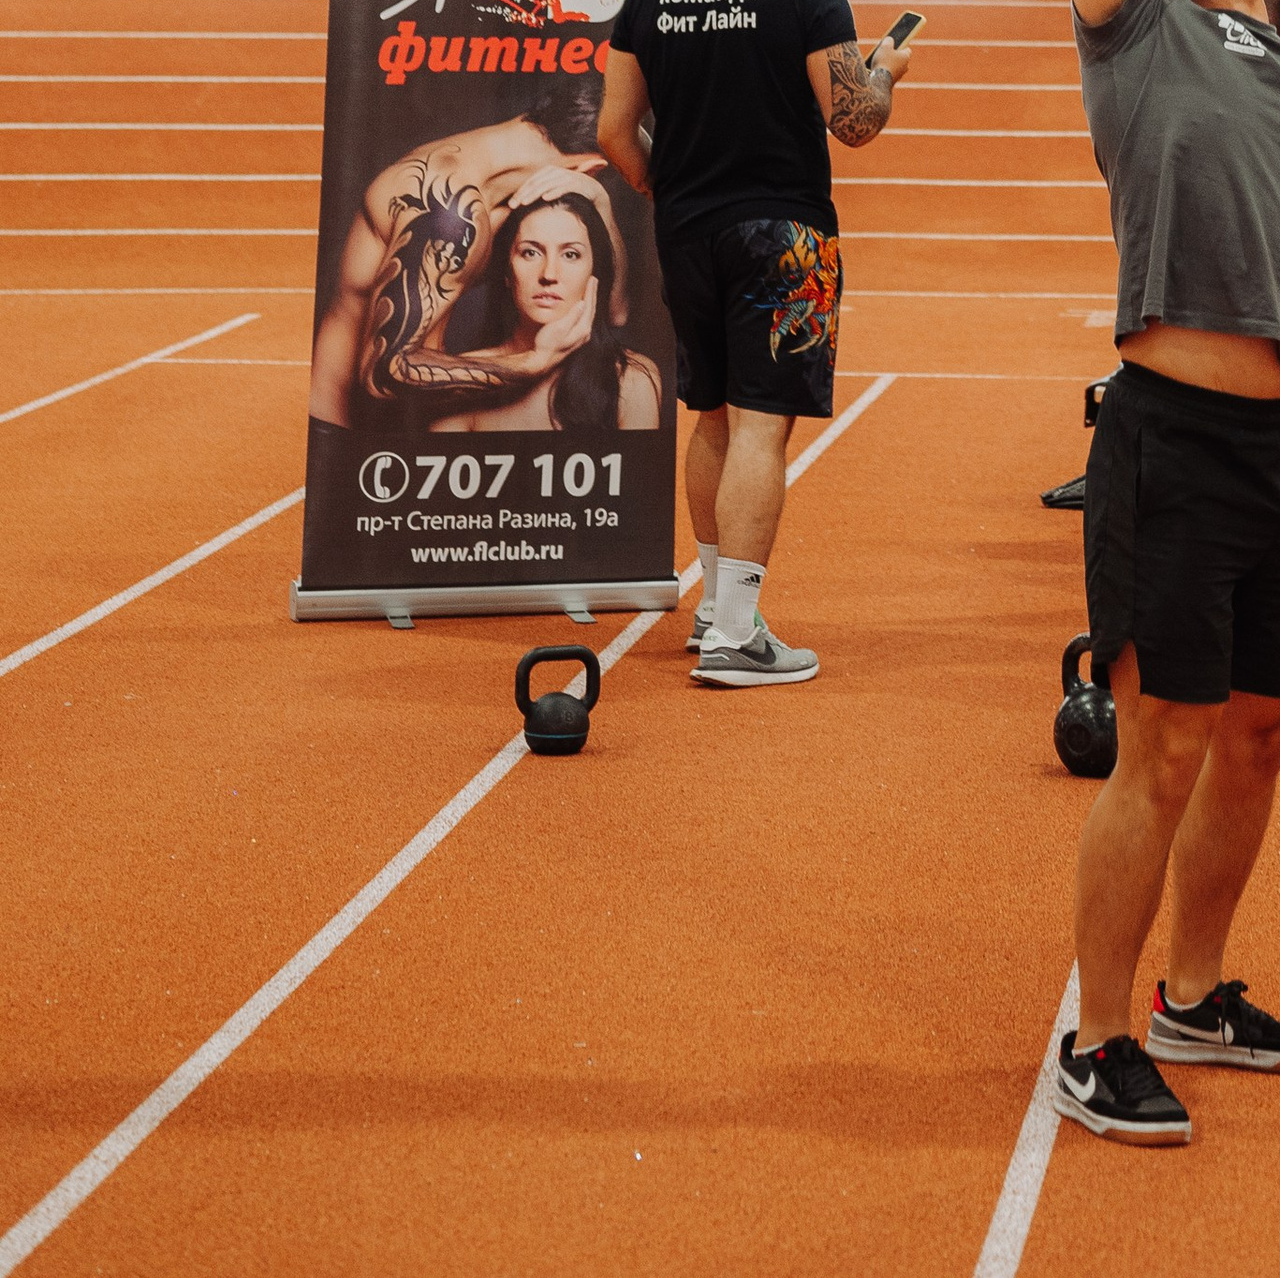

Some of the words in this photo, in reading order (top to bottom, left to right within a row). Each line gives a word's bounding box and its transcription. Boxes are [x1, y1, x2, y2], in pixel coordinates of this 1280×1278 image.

[656, 11, 698, 34] Фит
[702, 5, 757, 32] Лайн
[414, 453, 516, 500] 707
[533, 452, 624, 498] 101
[356, 512, 403, 537] пр-т
[406, 509, 494, 532] Степана
[499, 508, 577, 532] Разина,
[583, 507, 620, 529] 19а
